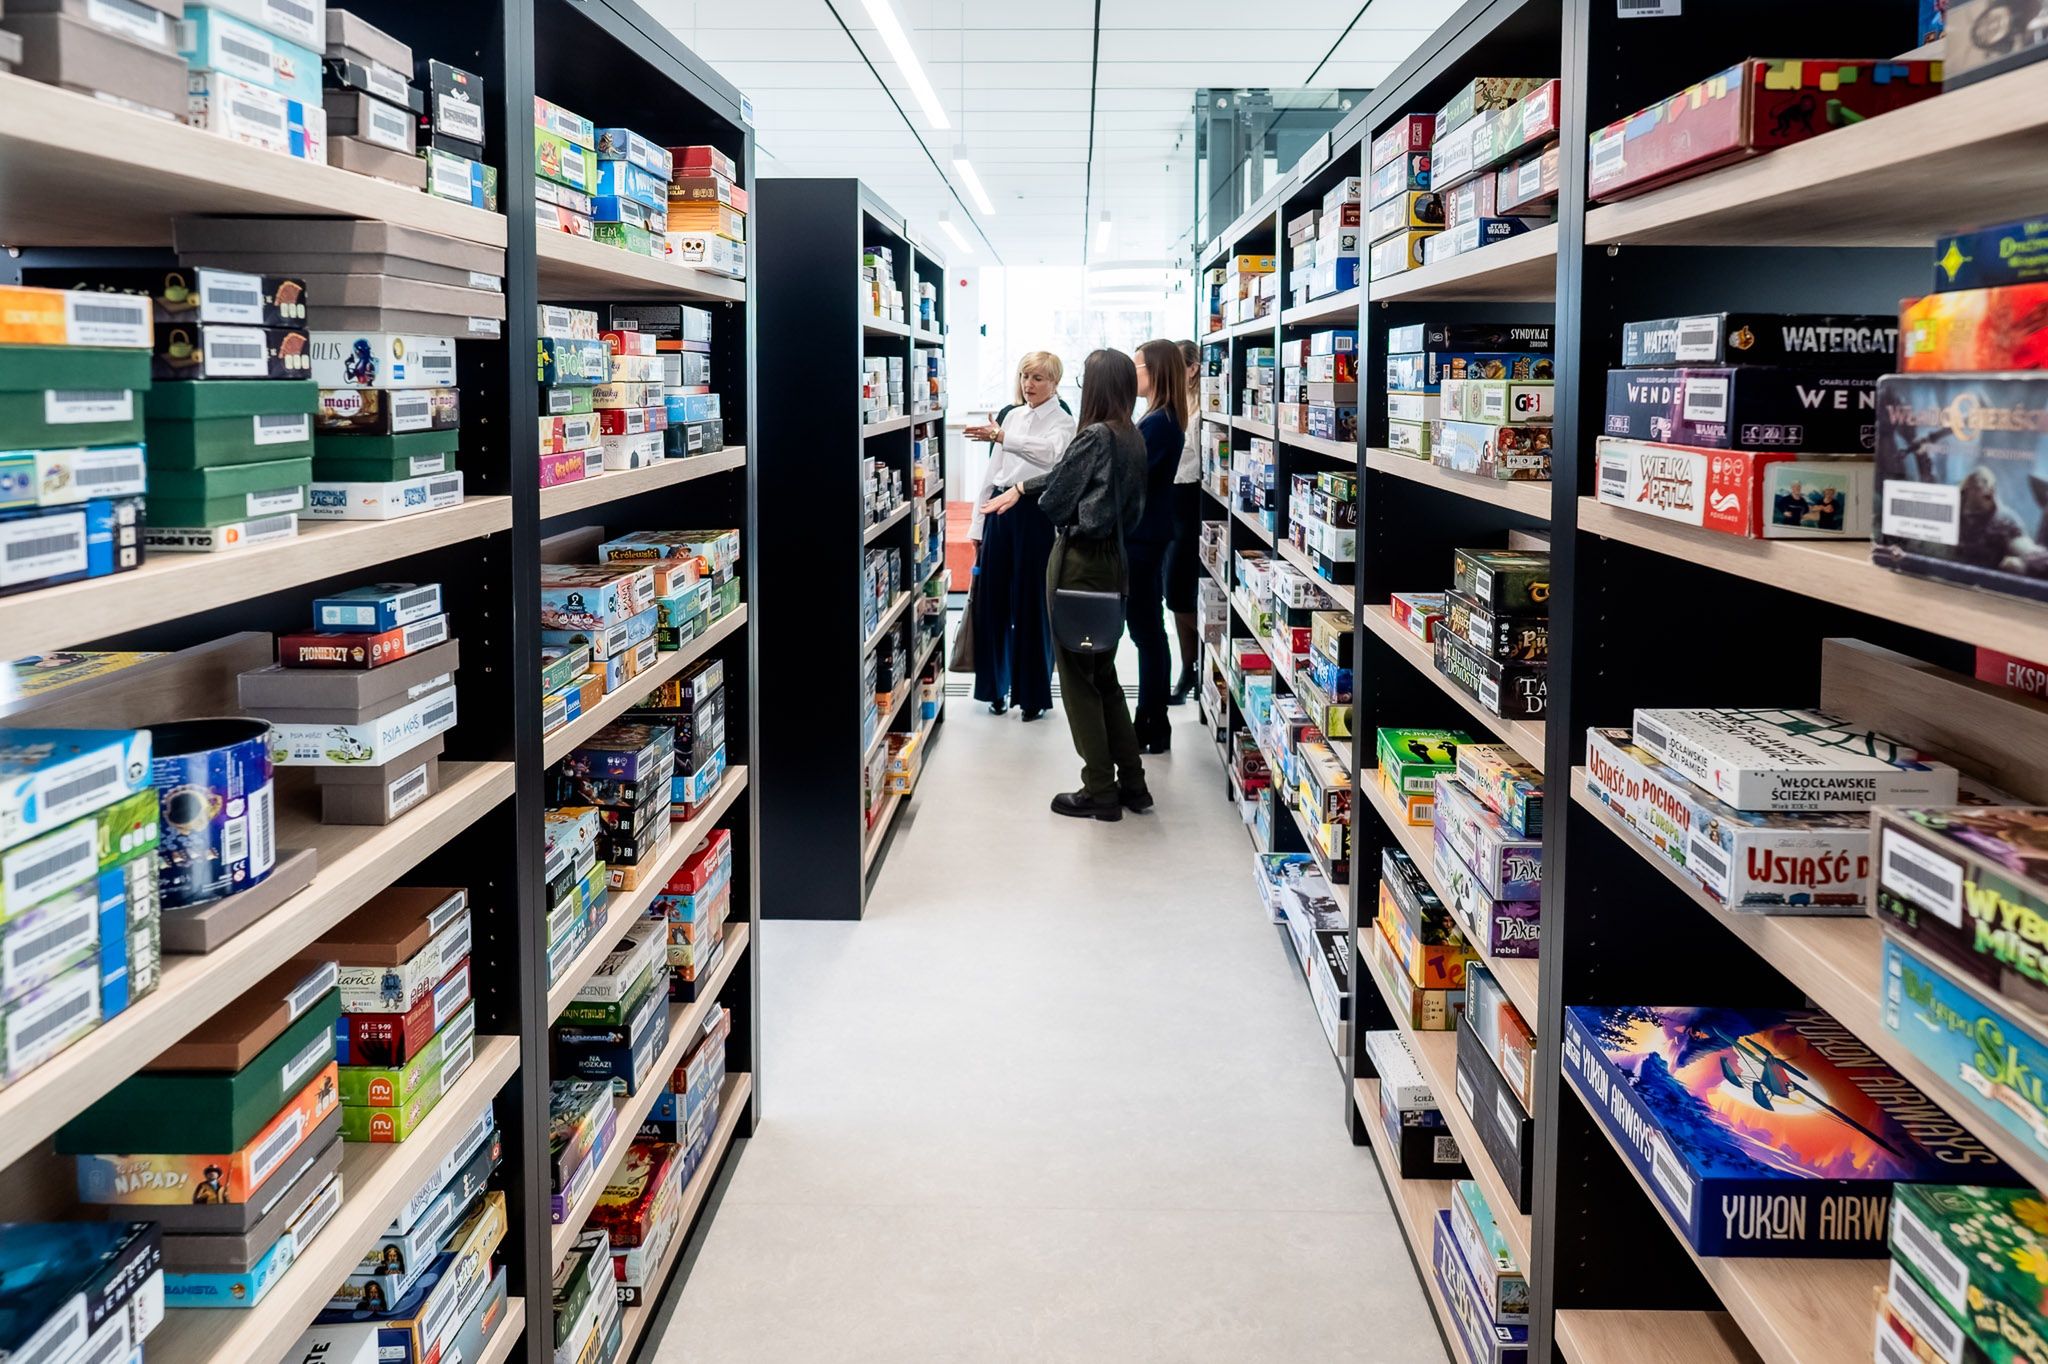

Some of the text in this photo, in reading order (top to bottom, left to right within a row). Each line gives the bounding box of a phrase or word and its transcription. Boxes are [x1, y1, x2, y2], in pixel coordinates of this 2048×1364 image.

[1510, 328, 1549, 340] SYNDYKAT
[324, 395, 361, 410] magii
[1695, 423, 1726, 437] WAMPIR
[1640, 454, 1694, 483] WIELKA
[1650, 478, 1695, 512] PĘTLA
[609, 549, 658, 560] Królewski
[299, 646, 348, 662] PIONIERZY
[1525, 695, 1546, 713] D
[382, 727, 401, 744] PSIA
[1590, 744, 1691, 831] WSIĄŚĆ DO POCIĄGU
[1780, 777, 1877, 789] WŁOCŁAWSKIE
[1771, 788, 1877, 804] ŚCIEŻKI PAMIĘCI
[1747, 847, 1850, 888] WSIĄŚĆ
[555, 870, 574, 900] LUCKY
[1495, 946, 1519, 954] rebel
[1785, 1010, 1888, 1068] YUKON
[1849, 1075, 1999, 1165] AIRWAYS
[1582, 1044, 1652, 1163] YUKON AIRWAYS
[115, 1171, 188, 1195] NAPAD!
[1722, 1195, 1805, 1240] YUKON
[94, 1249, 160, 1323] NEMESIS
